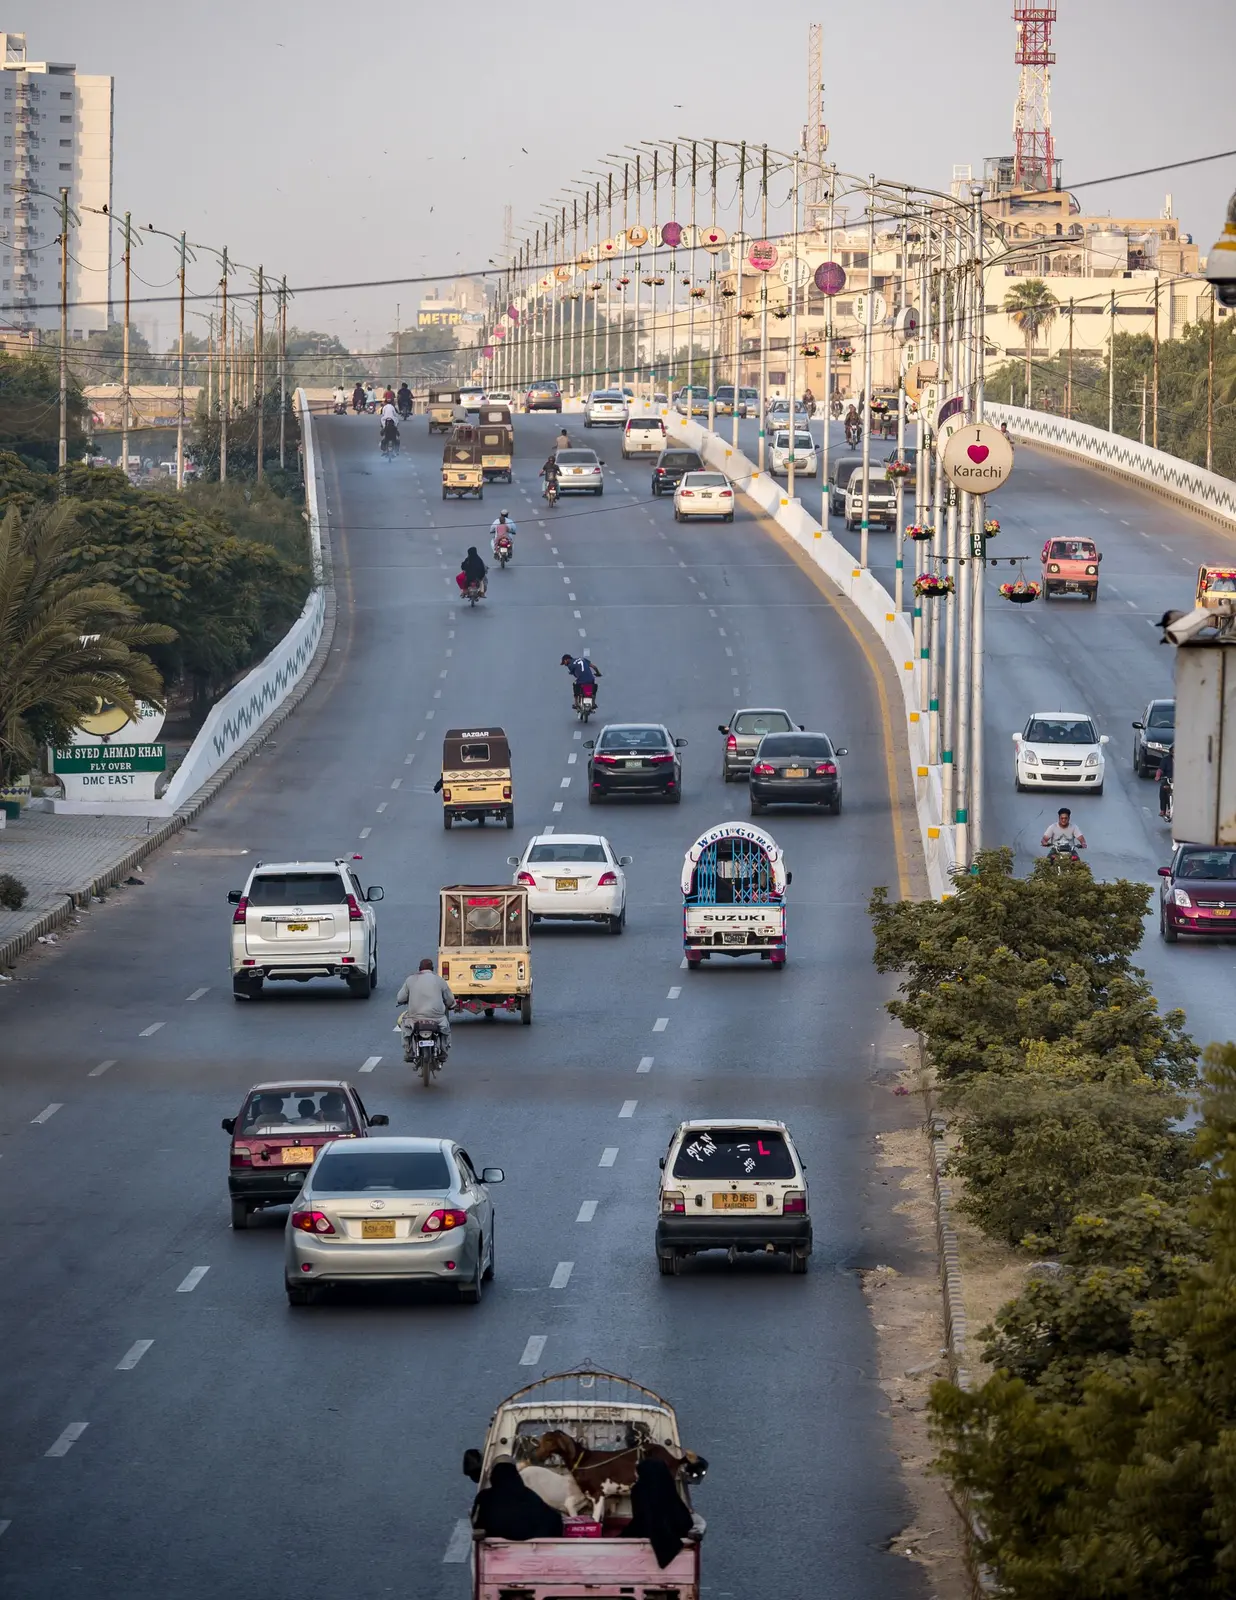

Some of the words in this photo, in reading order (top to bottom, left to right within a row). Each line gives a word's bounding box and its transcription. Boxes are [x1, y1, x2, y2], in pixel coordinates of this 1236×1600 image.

[975, 429, 981, 442] I
[953, 464, 1002, 478] Karachi
[974, 534, 982, 556] DMC
[56, 749, 73, 759] SIR
[75, 748, 100, 759] SYED
[103, 747, 136, 759] AHMAD
[138, 746, 163, 758] KHAN
[90, 763, 107, 771] FLY
[108, 762, 132, 770] OVER
[83, 776, 105, 785] DMC
[108, 775, 135, 785] EAST
